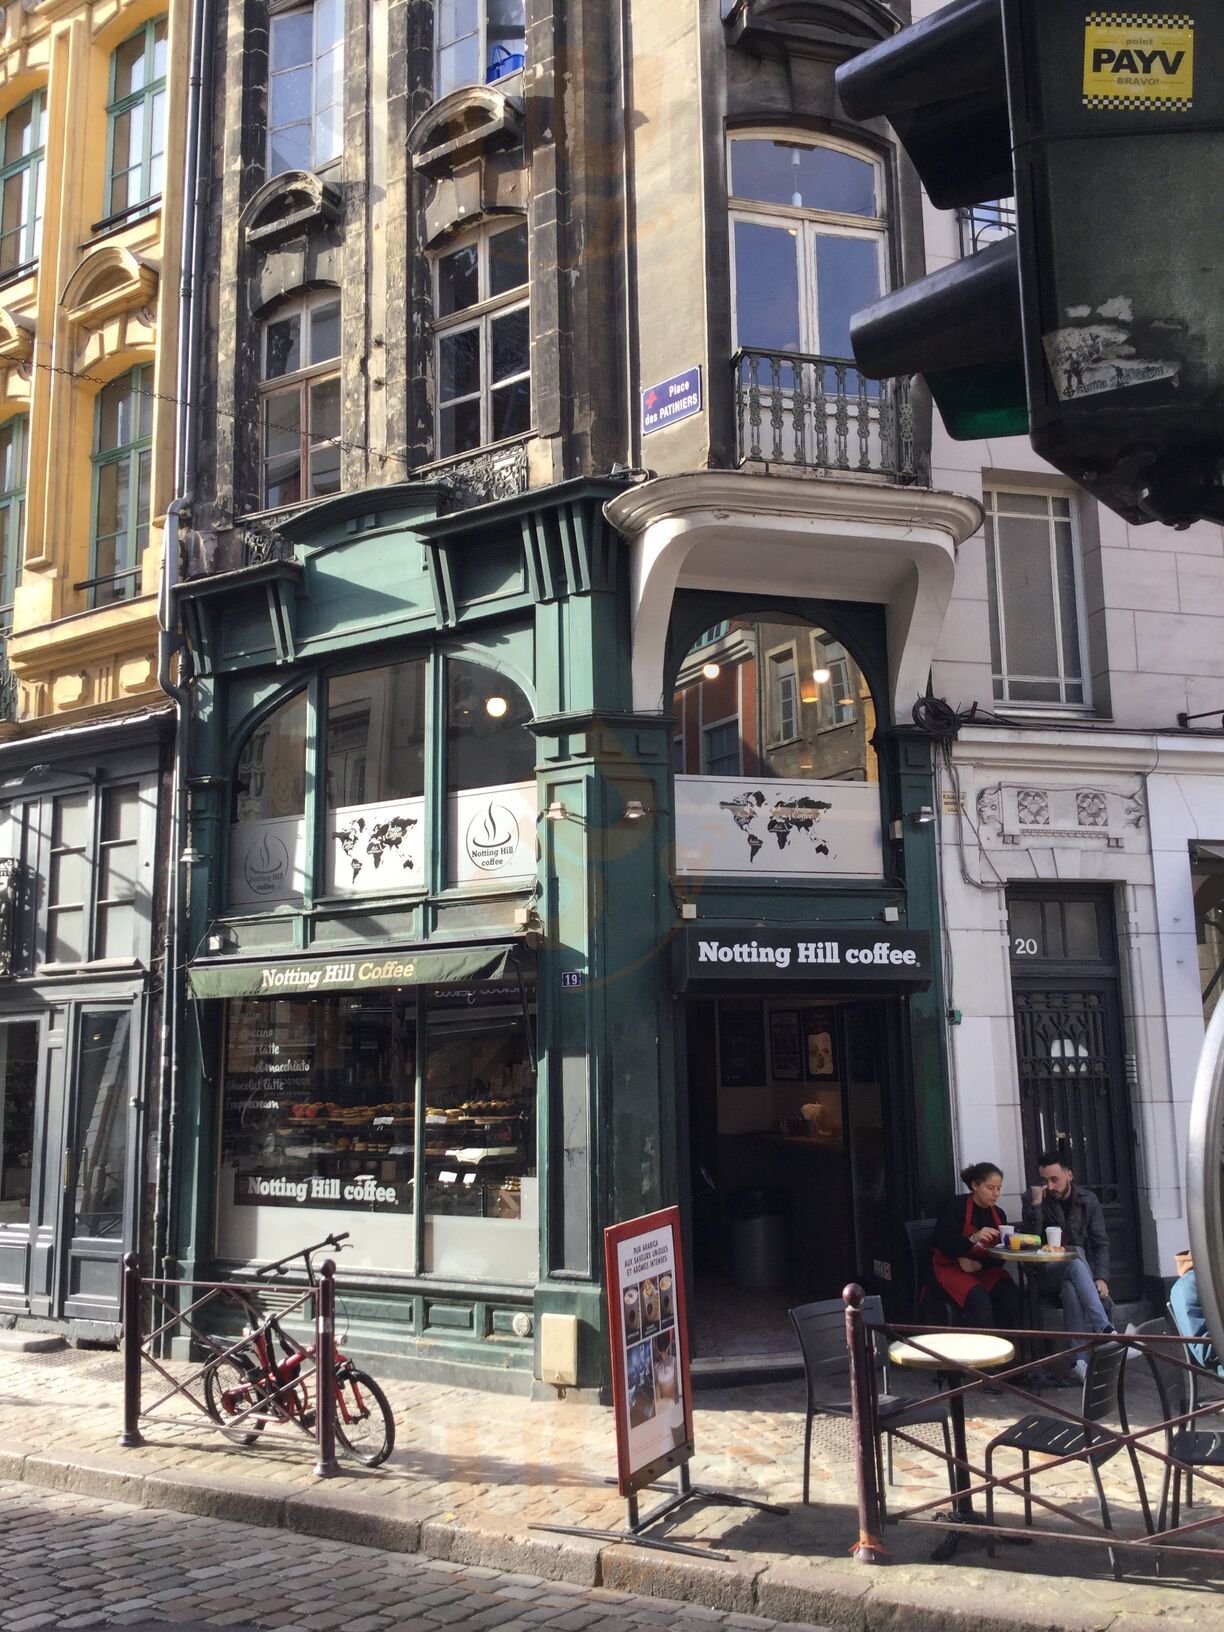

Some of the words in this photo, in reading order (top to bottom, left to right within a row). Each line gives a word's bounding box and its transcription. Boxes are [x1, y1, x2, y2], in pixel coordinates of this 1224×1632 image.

[1126, 38, 1154, 46] point
[1092, 48, 1186, 75] PAYV
[1116, 77, 1160, 86] BRAVO!
[669, 381, 690, 398] Place
[645, 413, 658, 426] des
[659, 393, 698, 420] PATINIERS
[472, 848, 499, 858] Notting
[500, 846, 514, 855] Hill
[481, 858, 504, 867] coffee
[272, 872, 284, 881] Hill
[698, 940, 792, 968] Notting
[797, 941, 841, 964] Hill
[845, 942, 917, 965] coffee
[1014, 938, 1038, 955] 20
[261, 967, 323, 989] Notting
[323, 963, 356, 983] Hill
[358, 960, 415, 981] Coffee
[565, 974, 578, 986] 19
[248, 1176, 308, 1202] Notting
[311, 1178, 341, 1199] Hill
[344, 1180, 396, 1202] coffee
[633, 1245, 641, 1255] PUR
[642, 1240, 659, 1251] ARABICA
[624, 1259, 633, 1268] AUX
[633, 1252, 652, 1265] SAVEURS
[652, 1245, 669, 1257] UNIQUES
[626, 1268, 632, 1277] ET
[650, 1255, 668, 1267] INTENSES
